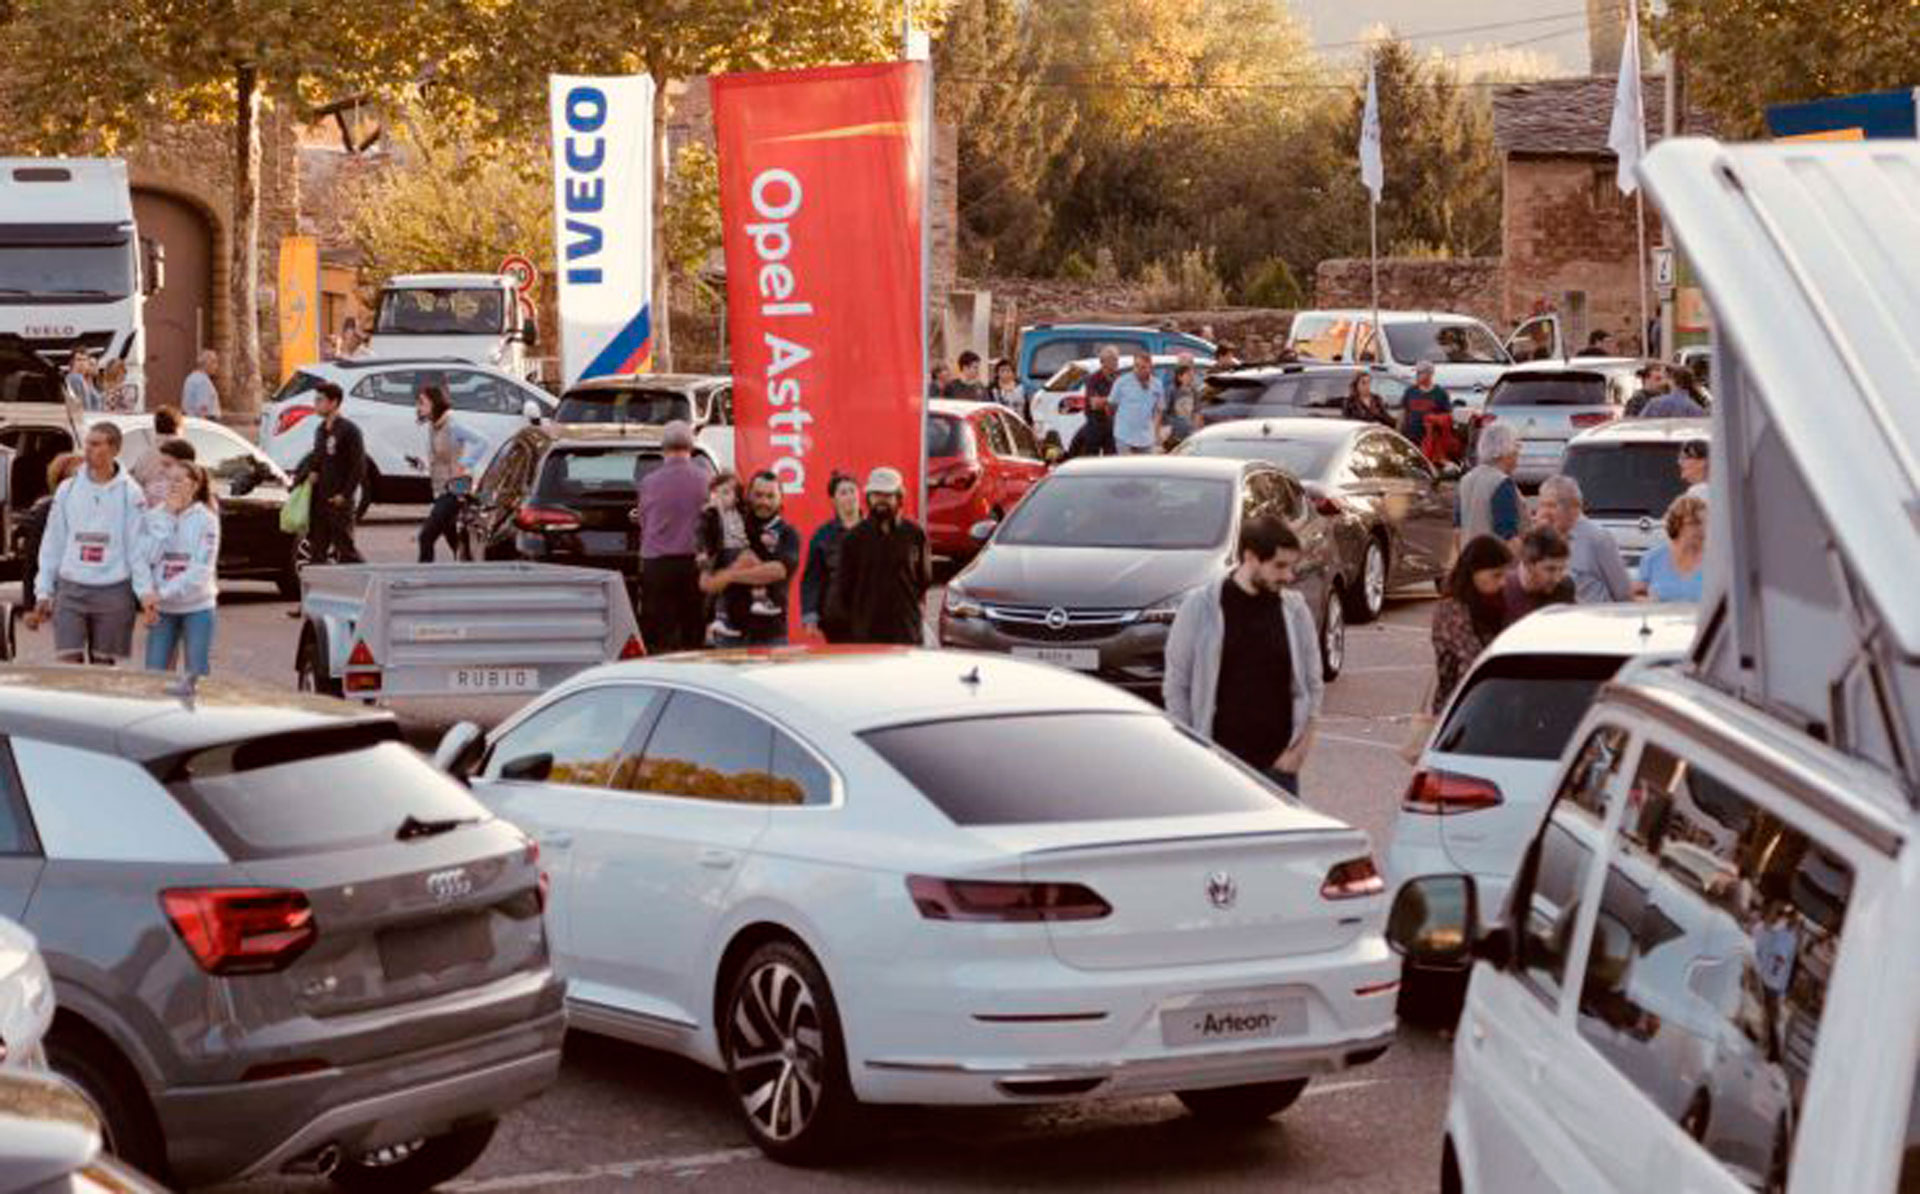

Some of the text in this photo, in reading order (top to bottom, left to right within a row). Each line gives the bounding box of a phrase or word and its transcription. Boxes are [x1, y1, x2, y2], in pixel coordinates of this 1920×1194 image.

[565, 86, 608, 284] IVECO
[744, 168, 814, 494] Opel Astra
[458, 670, 526, 686] RUBIO
